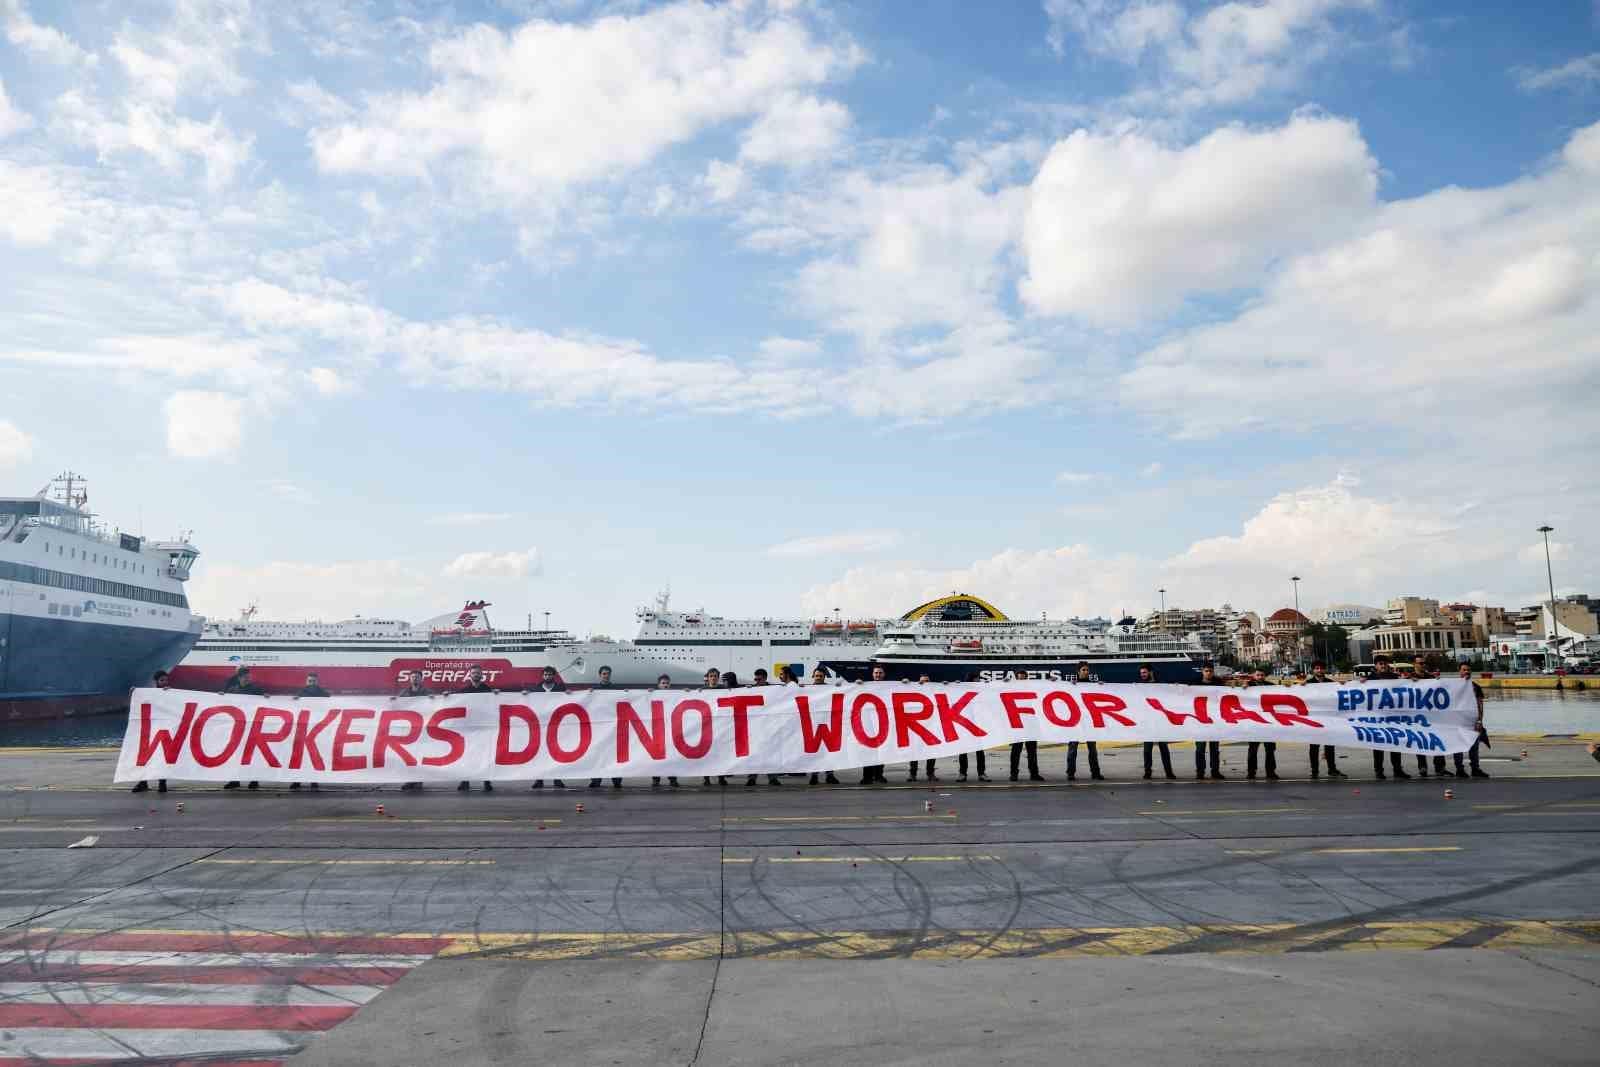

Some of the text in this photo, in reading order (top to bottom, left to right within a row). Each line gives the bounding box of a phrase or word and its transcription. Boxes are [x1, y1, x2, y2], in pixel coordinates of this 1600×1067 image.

[425, 660, 463, 669] Operated
[979, 670, 1062, 681] SEAETS
[1337, 687, 1451, 711] ΕΡΓΑΤΙΚΟ
[136, 703, 466, 772] WORKERS
[496, 703, 593, 766] DO
[617, 694, 765, 764] NOT
[795, 690, 988, 753] WORK
[999, 690, 1136, 729] FOR
[1352, 726, 1446, 752] ΠΕΙΡΑΙΑ
